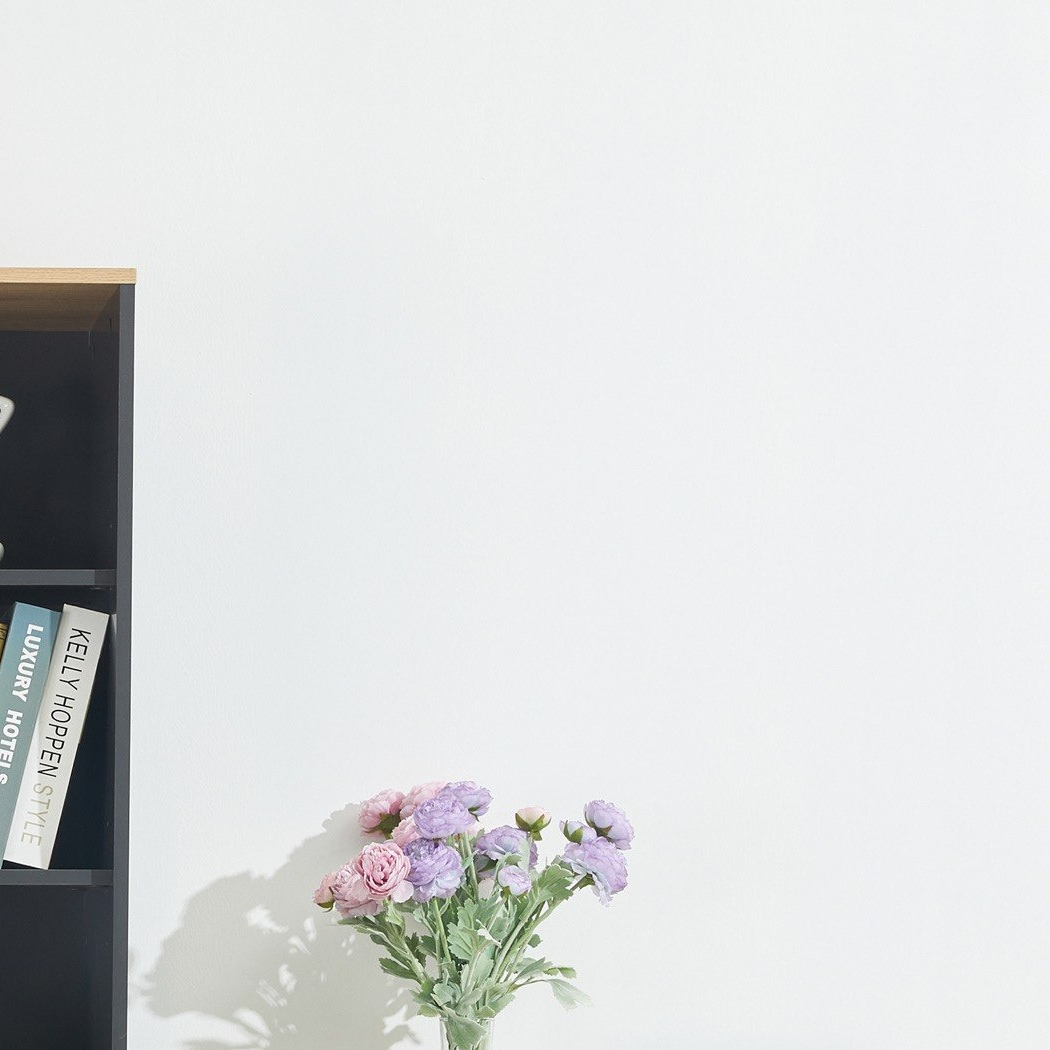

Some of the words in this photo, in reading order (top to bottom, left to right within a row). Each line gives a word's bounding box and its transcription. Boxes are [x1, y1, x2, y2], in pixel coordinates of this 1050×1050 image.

[13, 623, 44, 703] LUXURY
[59, 627, 92, 691] KELLY
[37, 694, 76, 778] HOPPEN
[21, 782, 54, 847] STYLE
